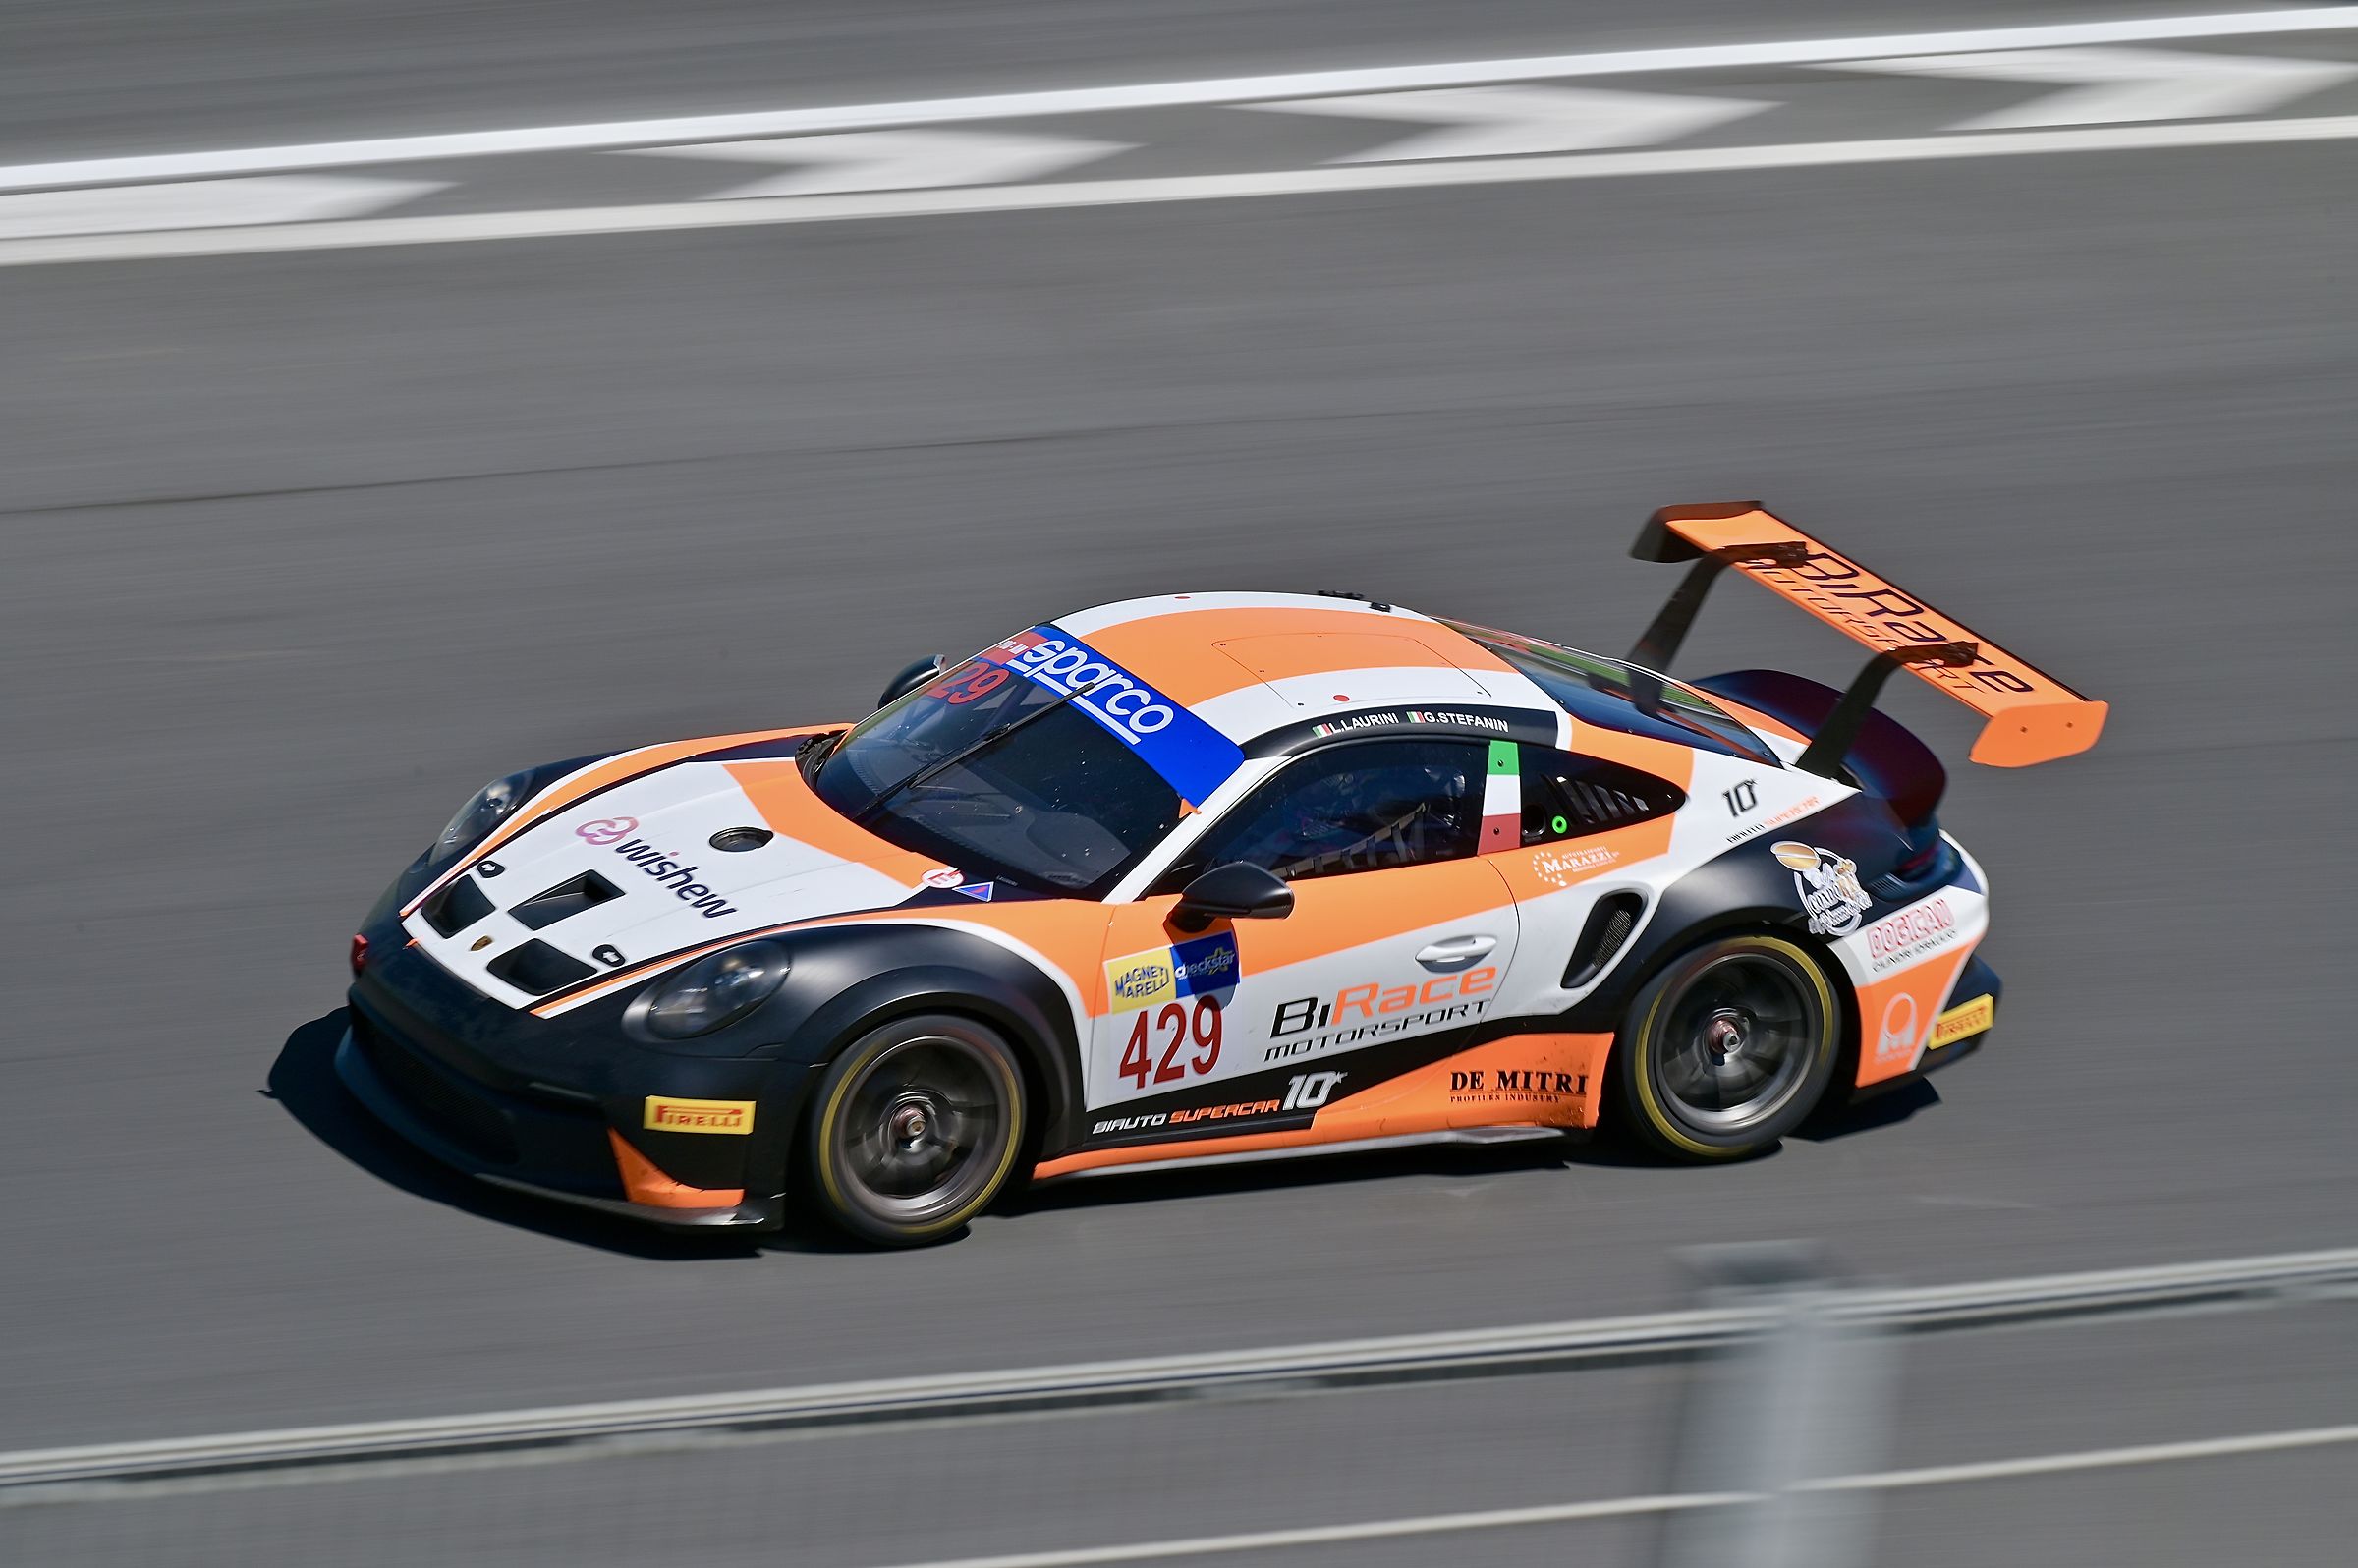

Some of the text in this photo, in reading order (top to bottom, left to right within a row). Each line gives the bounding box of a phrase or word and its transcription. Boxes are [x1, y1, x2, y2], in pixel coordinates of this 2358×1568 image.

[1789, 552, 2036, 694] BiRae
[1022, 639, 1175, 735] sparco
[1328, 711, 1509, 734] L.LAURINI G.STEFANIN
[615, 838, 737, 920] wishew
[1541, 852, 1612, 874] MARAZZI
[1118, 994, 1223, 1091] 429
[1263, 998, 1491, 1063] MOTORSPORT
[1093, 1071, 1337, 1135] BIAUTO SUPERCAR 10
[1450, 1069, 1589, 1095] DE MITRI
[1505, 1094, 1561, 1103] INDUSTRY
[655, 1105, 744, 1128] PIRELLI
